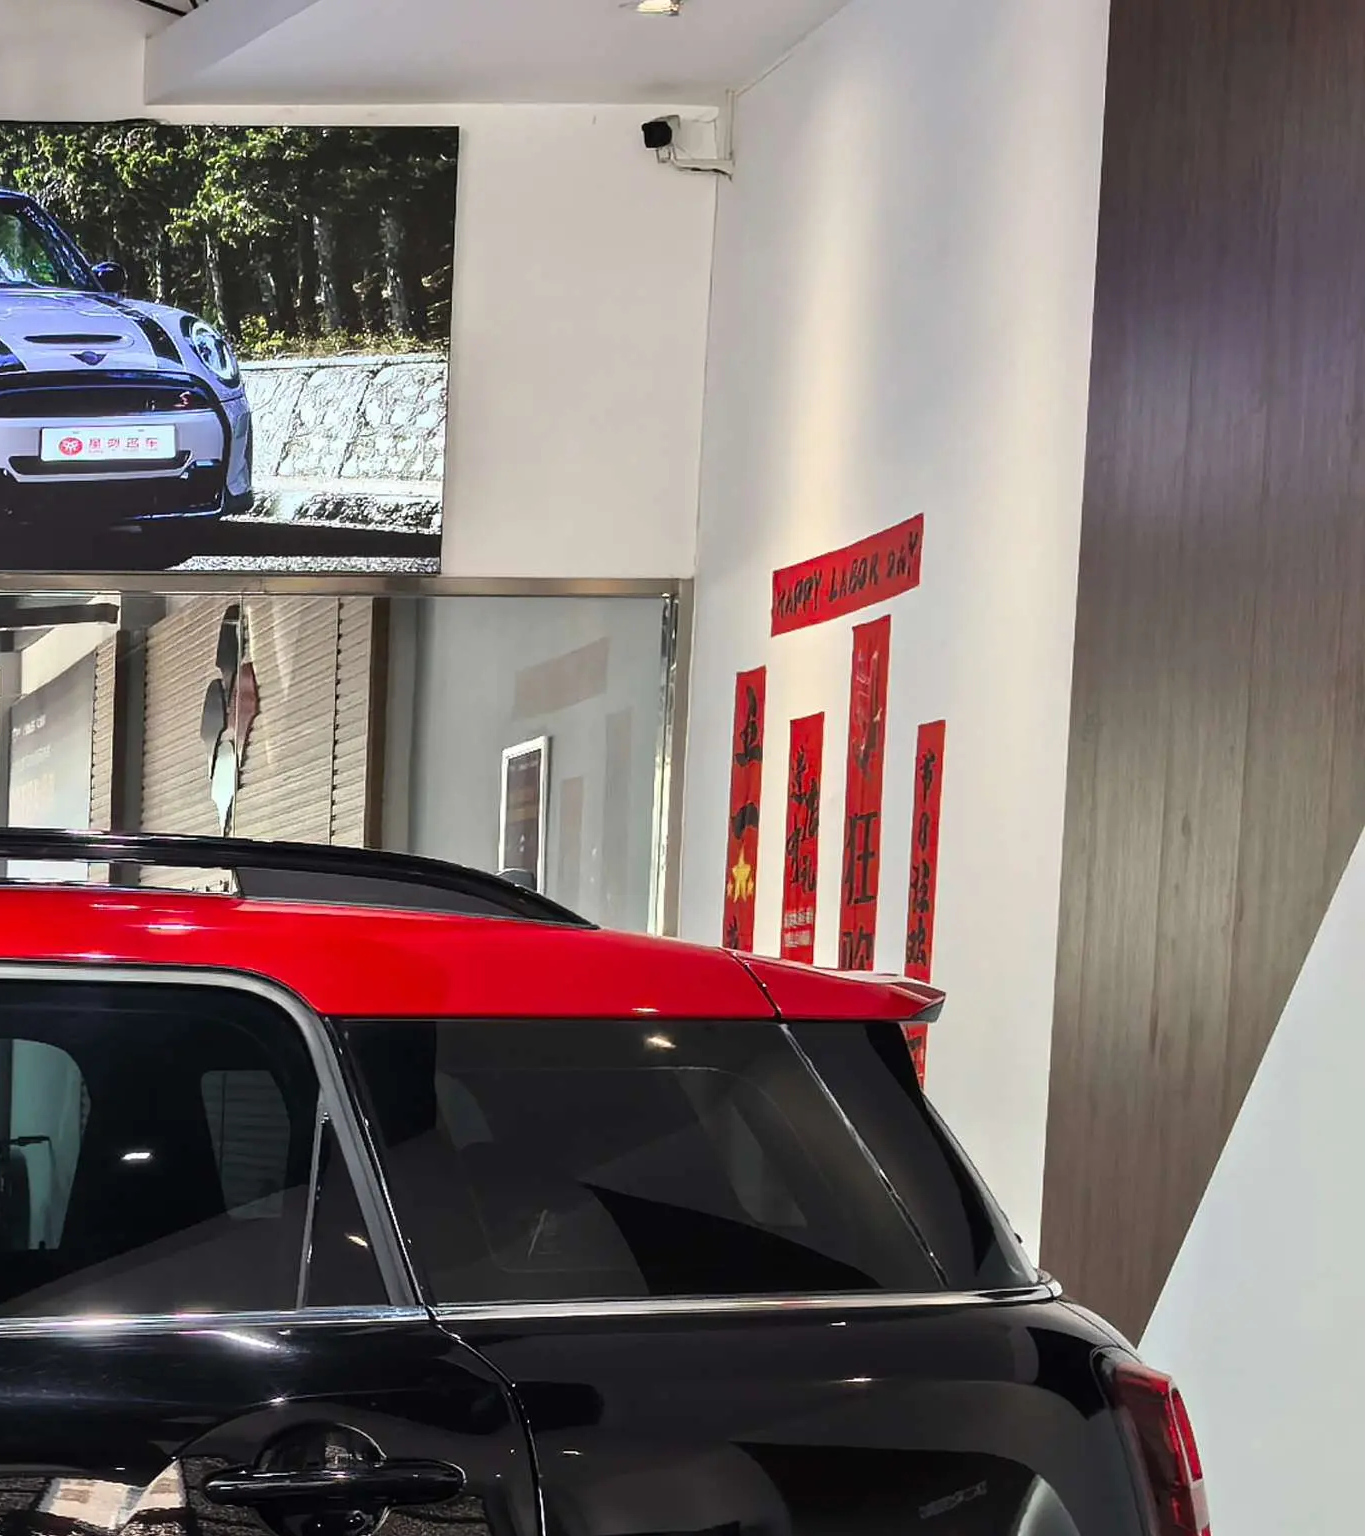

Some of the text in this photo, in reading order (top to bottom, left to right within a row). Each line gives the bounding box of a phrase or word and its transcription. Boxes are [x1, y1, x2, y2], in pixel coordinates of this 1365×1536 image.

[775, 531, 919, 619] HAPPY LABOR DAY
